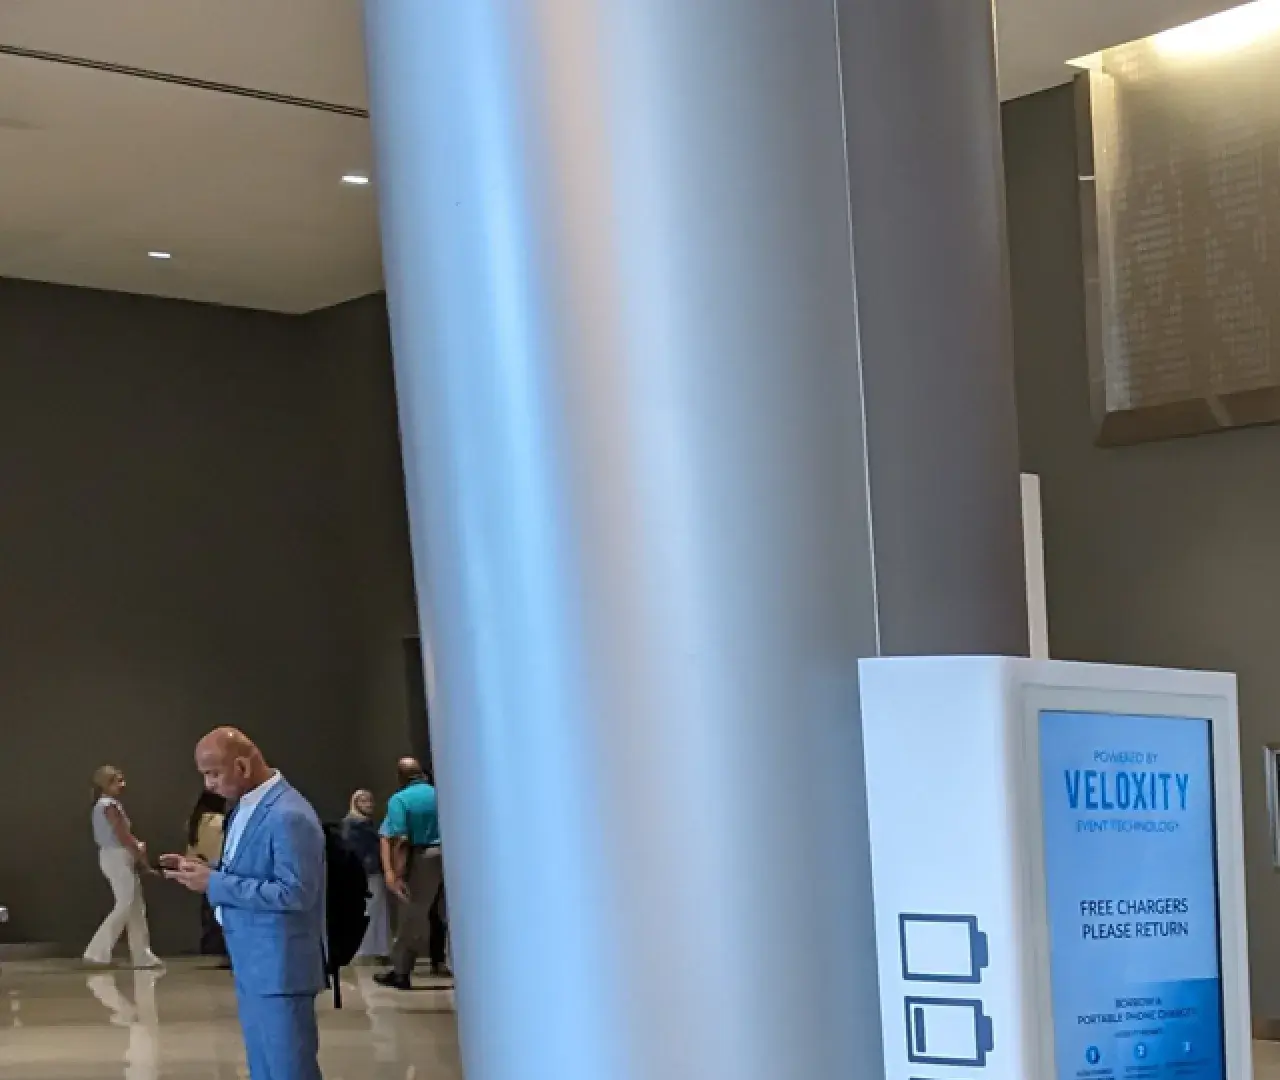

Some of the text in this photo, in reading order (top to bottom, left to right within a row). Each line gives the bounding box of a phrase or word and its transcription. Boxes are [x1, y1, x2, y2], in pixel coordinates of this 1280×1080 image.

[1064, 769, 1189, 811] VELOXITY
[1080, 897, 1189, 917] FREE CHARGERS
[1082, 921, 1189, 940] PLEASE RETURN
